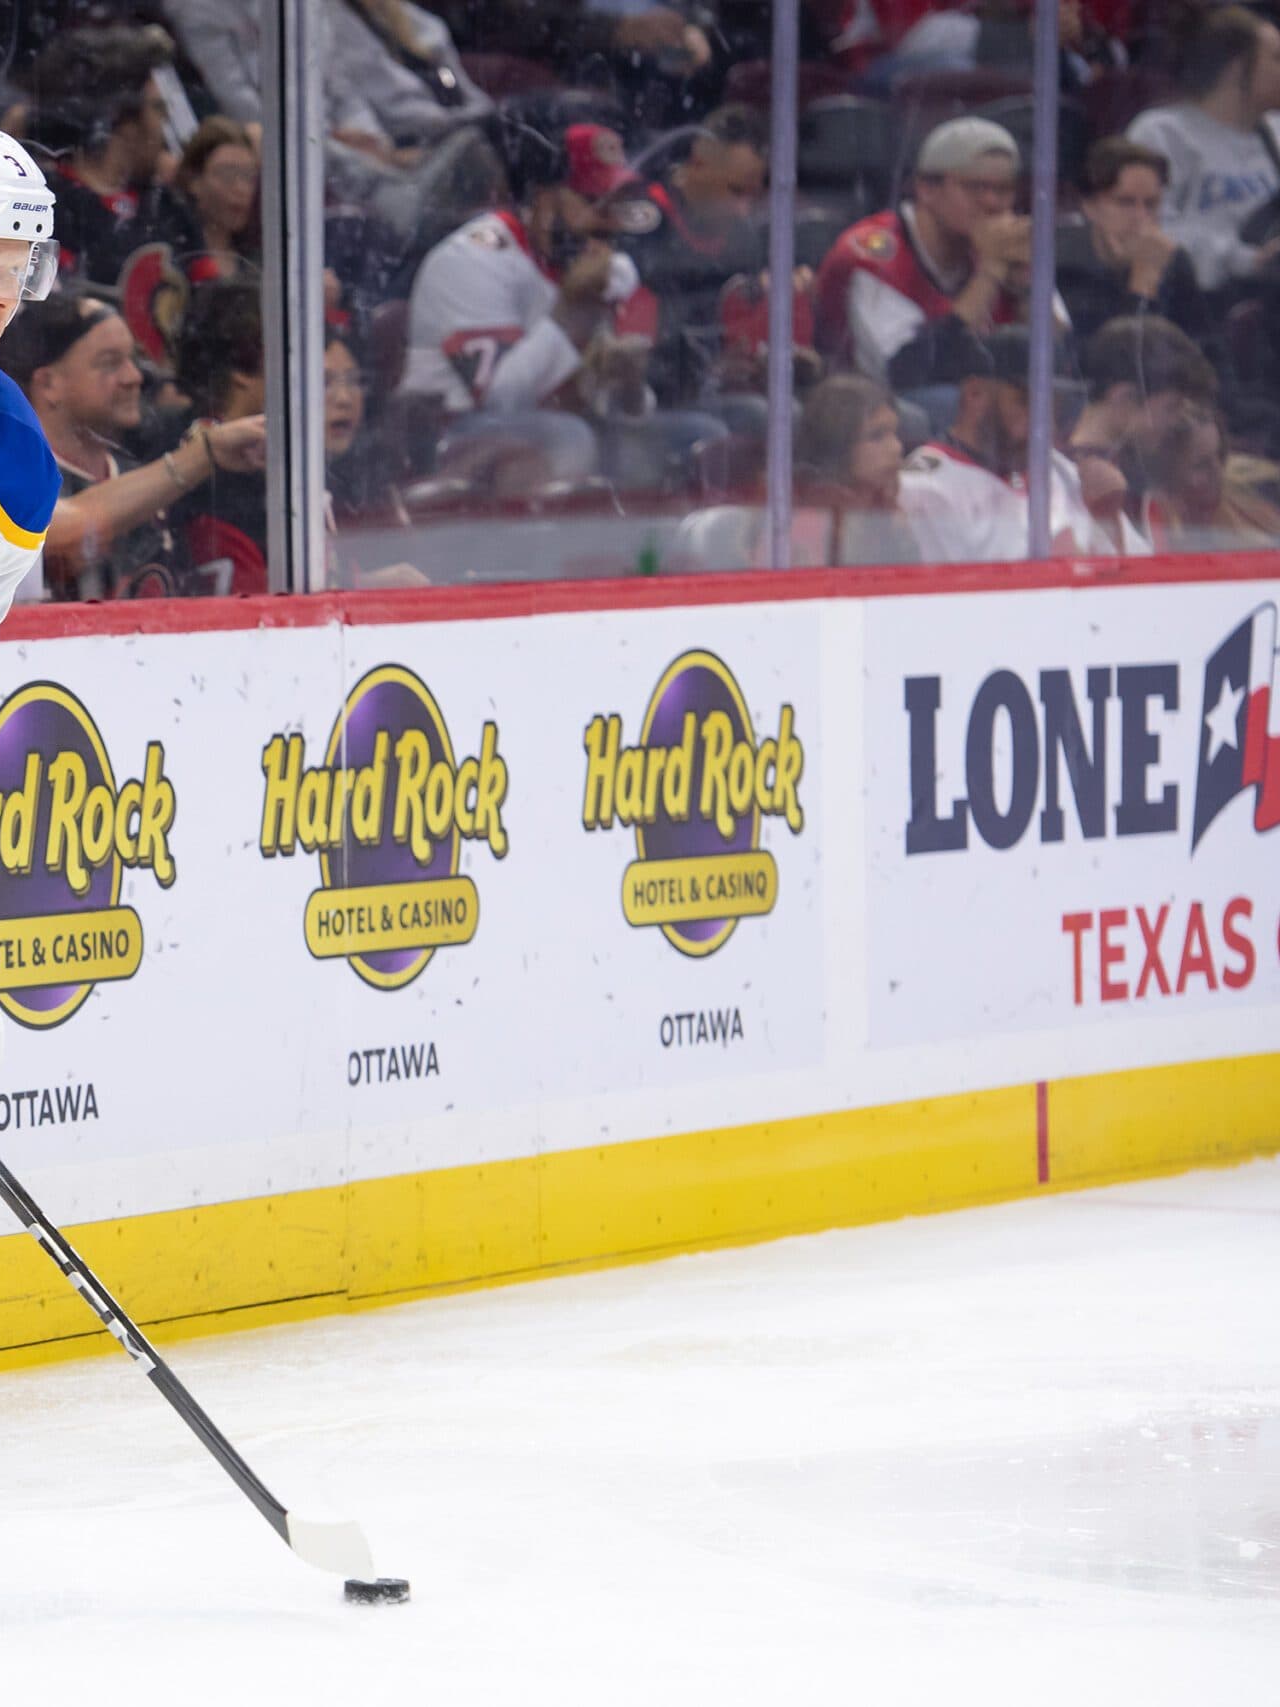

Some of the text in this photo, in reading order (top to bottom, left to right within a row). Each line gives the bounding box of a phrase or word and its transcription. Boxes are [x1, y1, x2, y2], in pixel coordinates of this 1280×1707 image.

[4, 155, 27, 177] 3
[583, 704, 804, 839] Hard Rock
[904, 662, 1179, 856] LONE
[260, 721, 509, 866] Hard Rock
[46, 741, 176, 894] Rock
[633, 869, 768, 907] HOTEL & CASINO
[317, 897, 468, 937] HOTEL & CASINO
[32, 937, 46, 966] &
[52, 928, 129, 964] CASINO
[1062, 895, 1257, 1007] TEXAS
[661, 1007, 743, 1048] OTTAWA
[348, 1042, 440, 1087] OTTAWA
